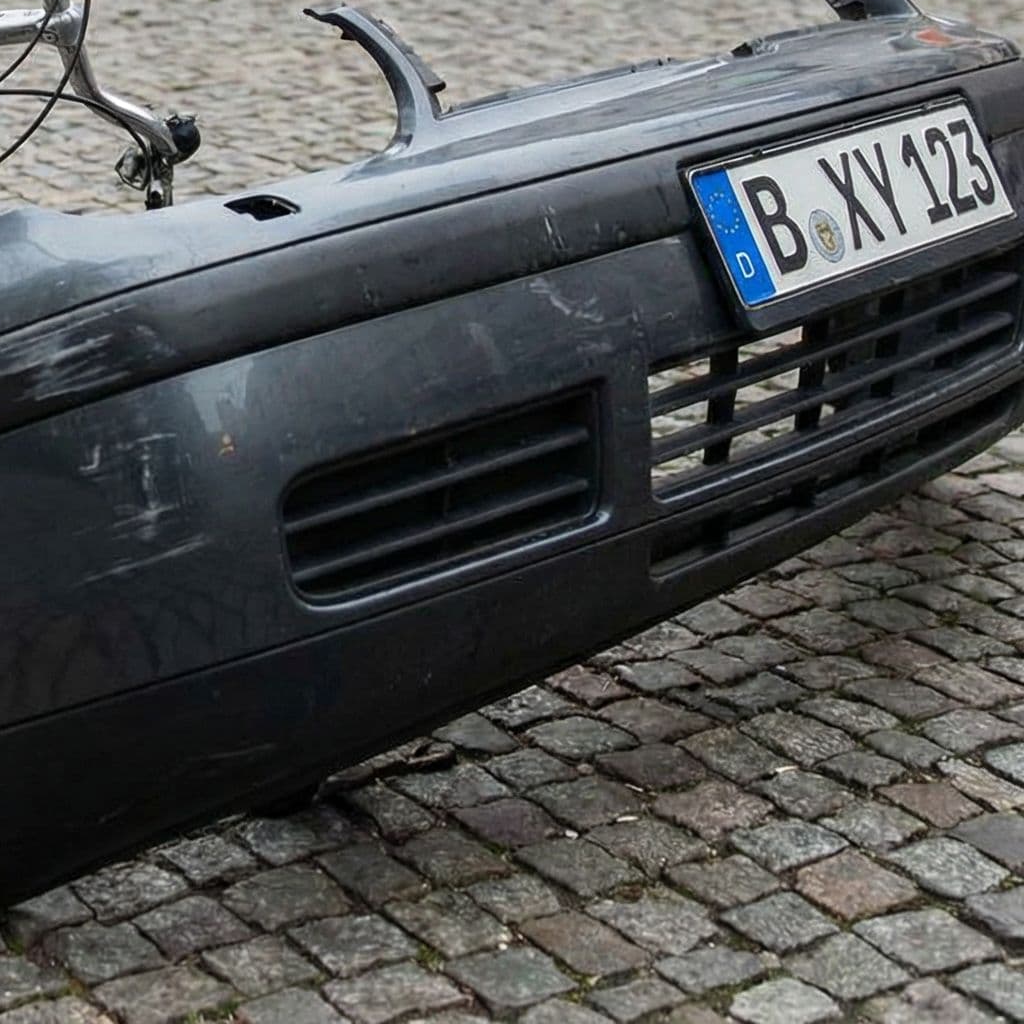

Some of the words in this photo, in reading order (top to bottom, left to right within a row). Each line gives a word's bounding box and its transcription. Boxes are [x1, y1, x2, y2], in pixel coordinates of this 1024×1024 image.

[742, 176, 808, 275] B
[818, 143, 907, 250] XY
[901, 119, 995, 225] 123
[736, 252, 755, 278] D
